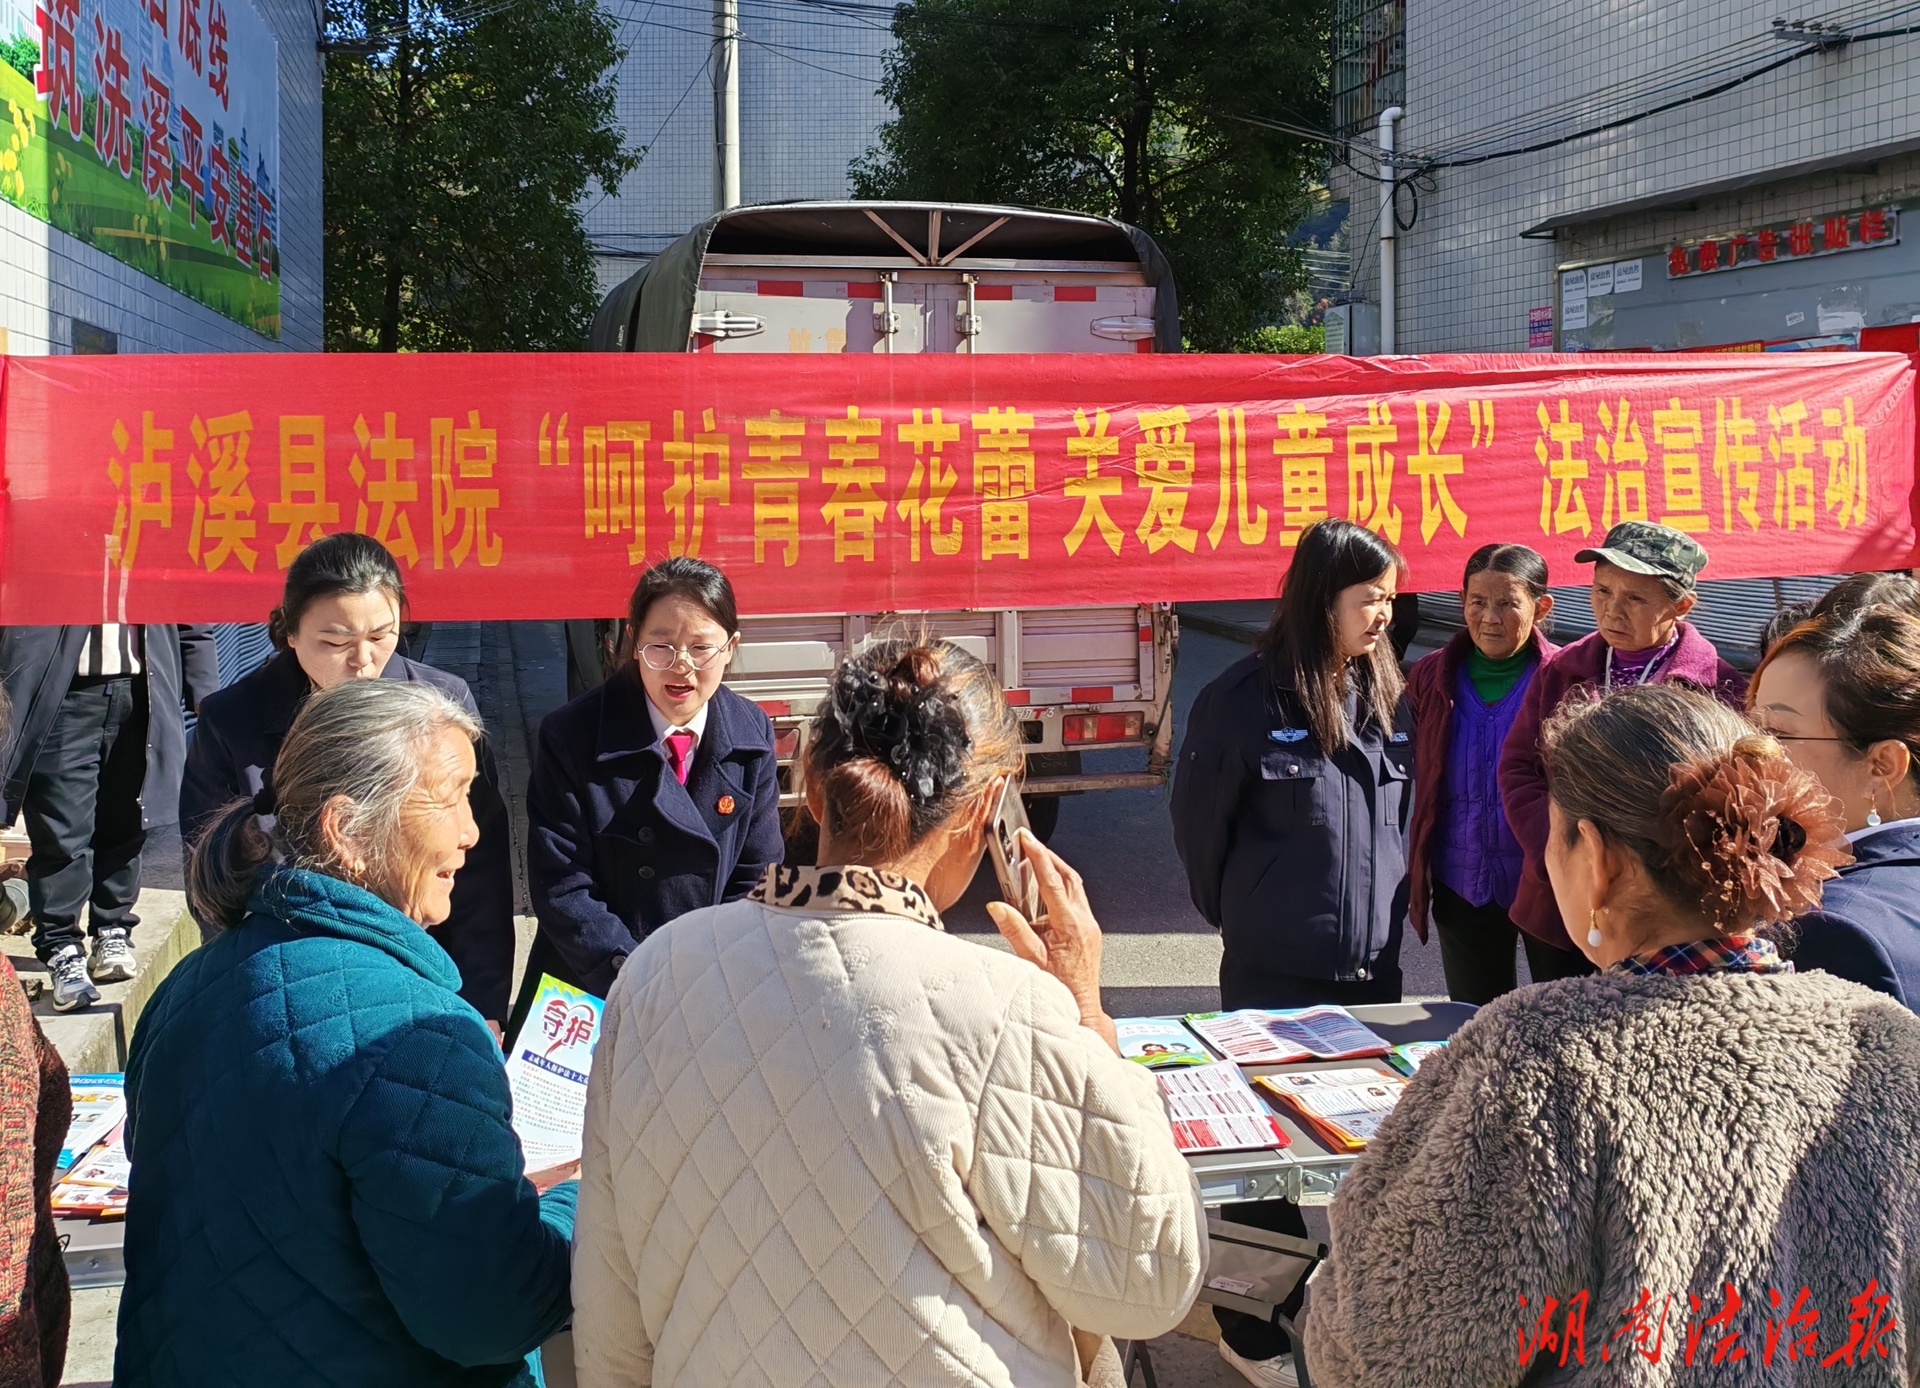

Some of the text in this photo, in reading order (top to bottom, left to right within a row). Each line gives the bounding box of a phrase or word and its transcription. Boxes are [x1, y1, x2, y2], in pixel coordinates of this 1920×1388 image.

[1669, 209, 1888, 276] 免费广告张贴栏
[107, 409, 503, 574] 泸溪县法院
[1534, 396, 1868, 539] 法治宣传活动
[543, 1004, 594, 1046] 守护
